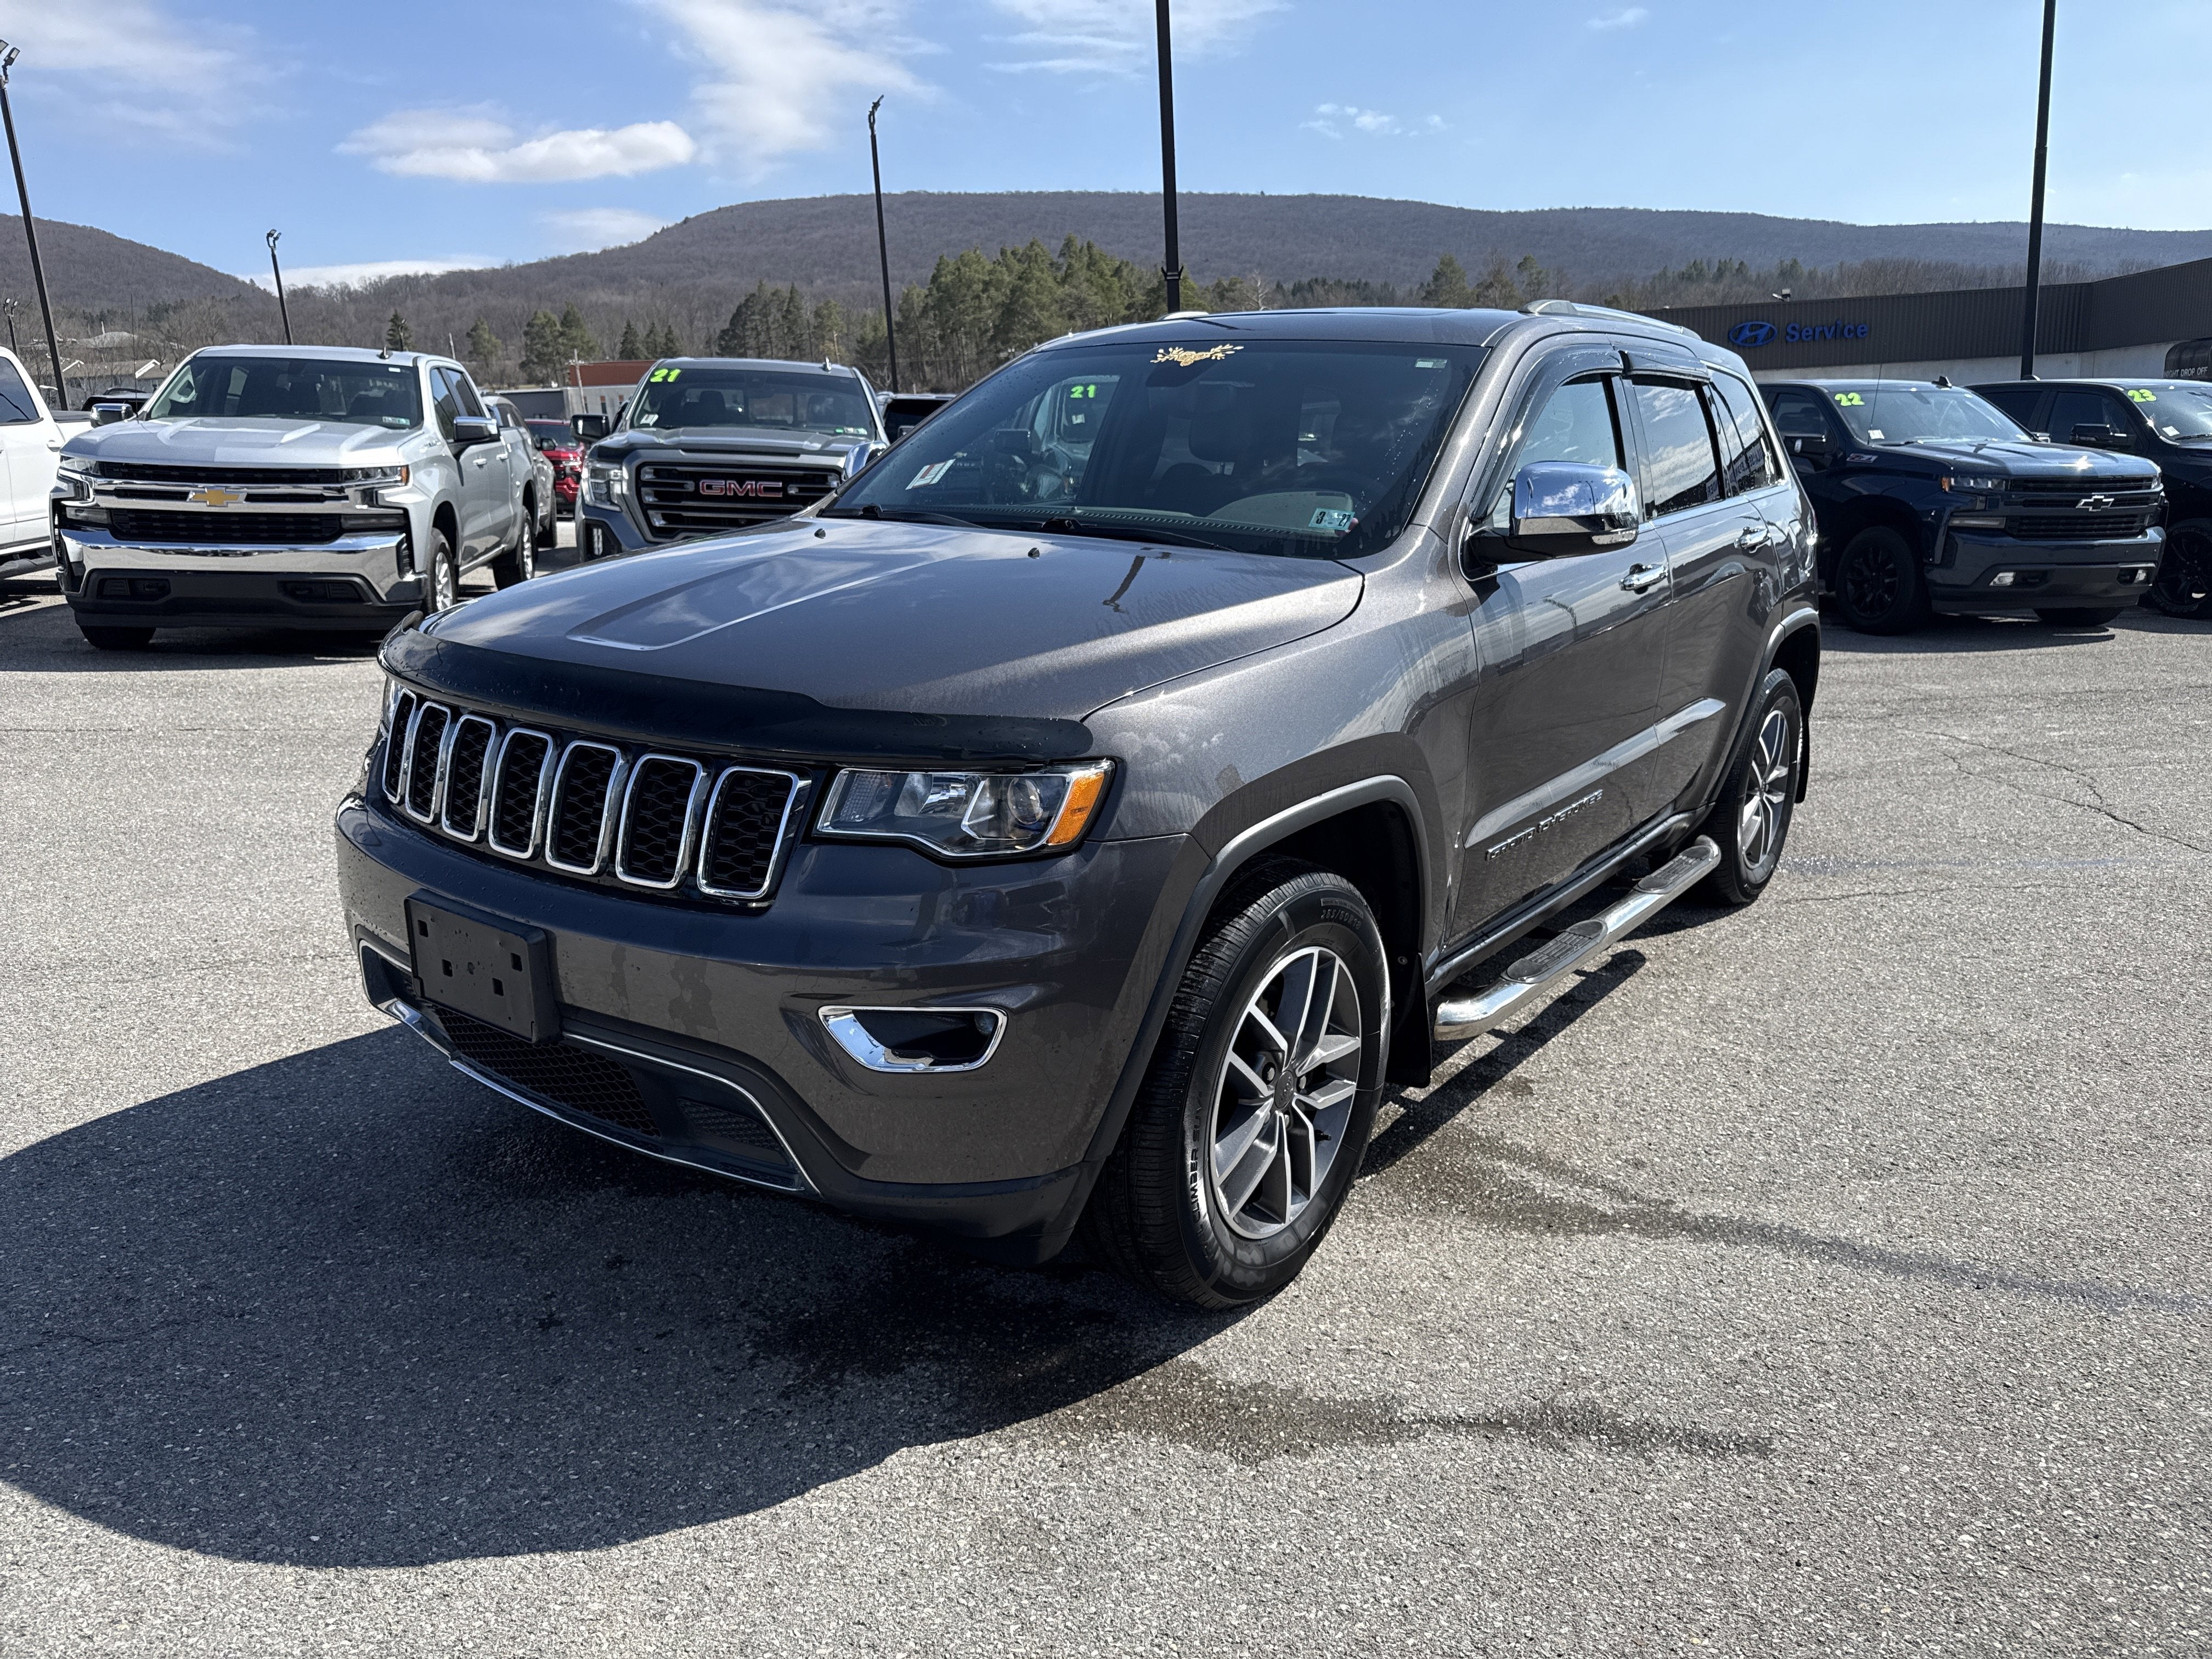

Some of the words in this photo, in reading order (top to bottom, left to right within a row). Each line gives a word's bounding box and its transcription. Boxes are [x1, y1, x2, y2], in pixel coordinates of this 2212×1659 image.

[1786, 320, 1869, 343] Service
[650, 369, 681, 382] 21
[2164, 369, 2180, 379] NIGHT
[2180, 368, 2196, 377] DROP
[2197, 366, 2208, 376] OFF
[1070, 385, 1096, 398] 21
[2128, 389, 2157, 402] 23
[1834, 392, 1865, 406] 22
[699, 479, 783, 498] GMC
[1316, 511, 1326, 524] 3
[1485, 827, 1536, 862] GRAND
[1537, 789, 1603, 834] CHEROKEE
